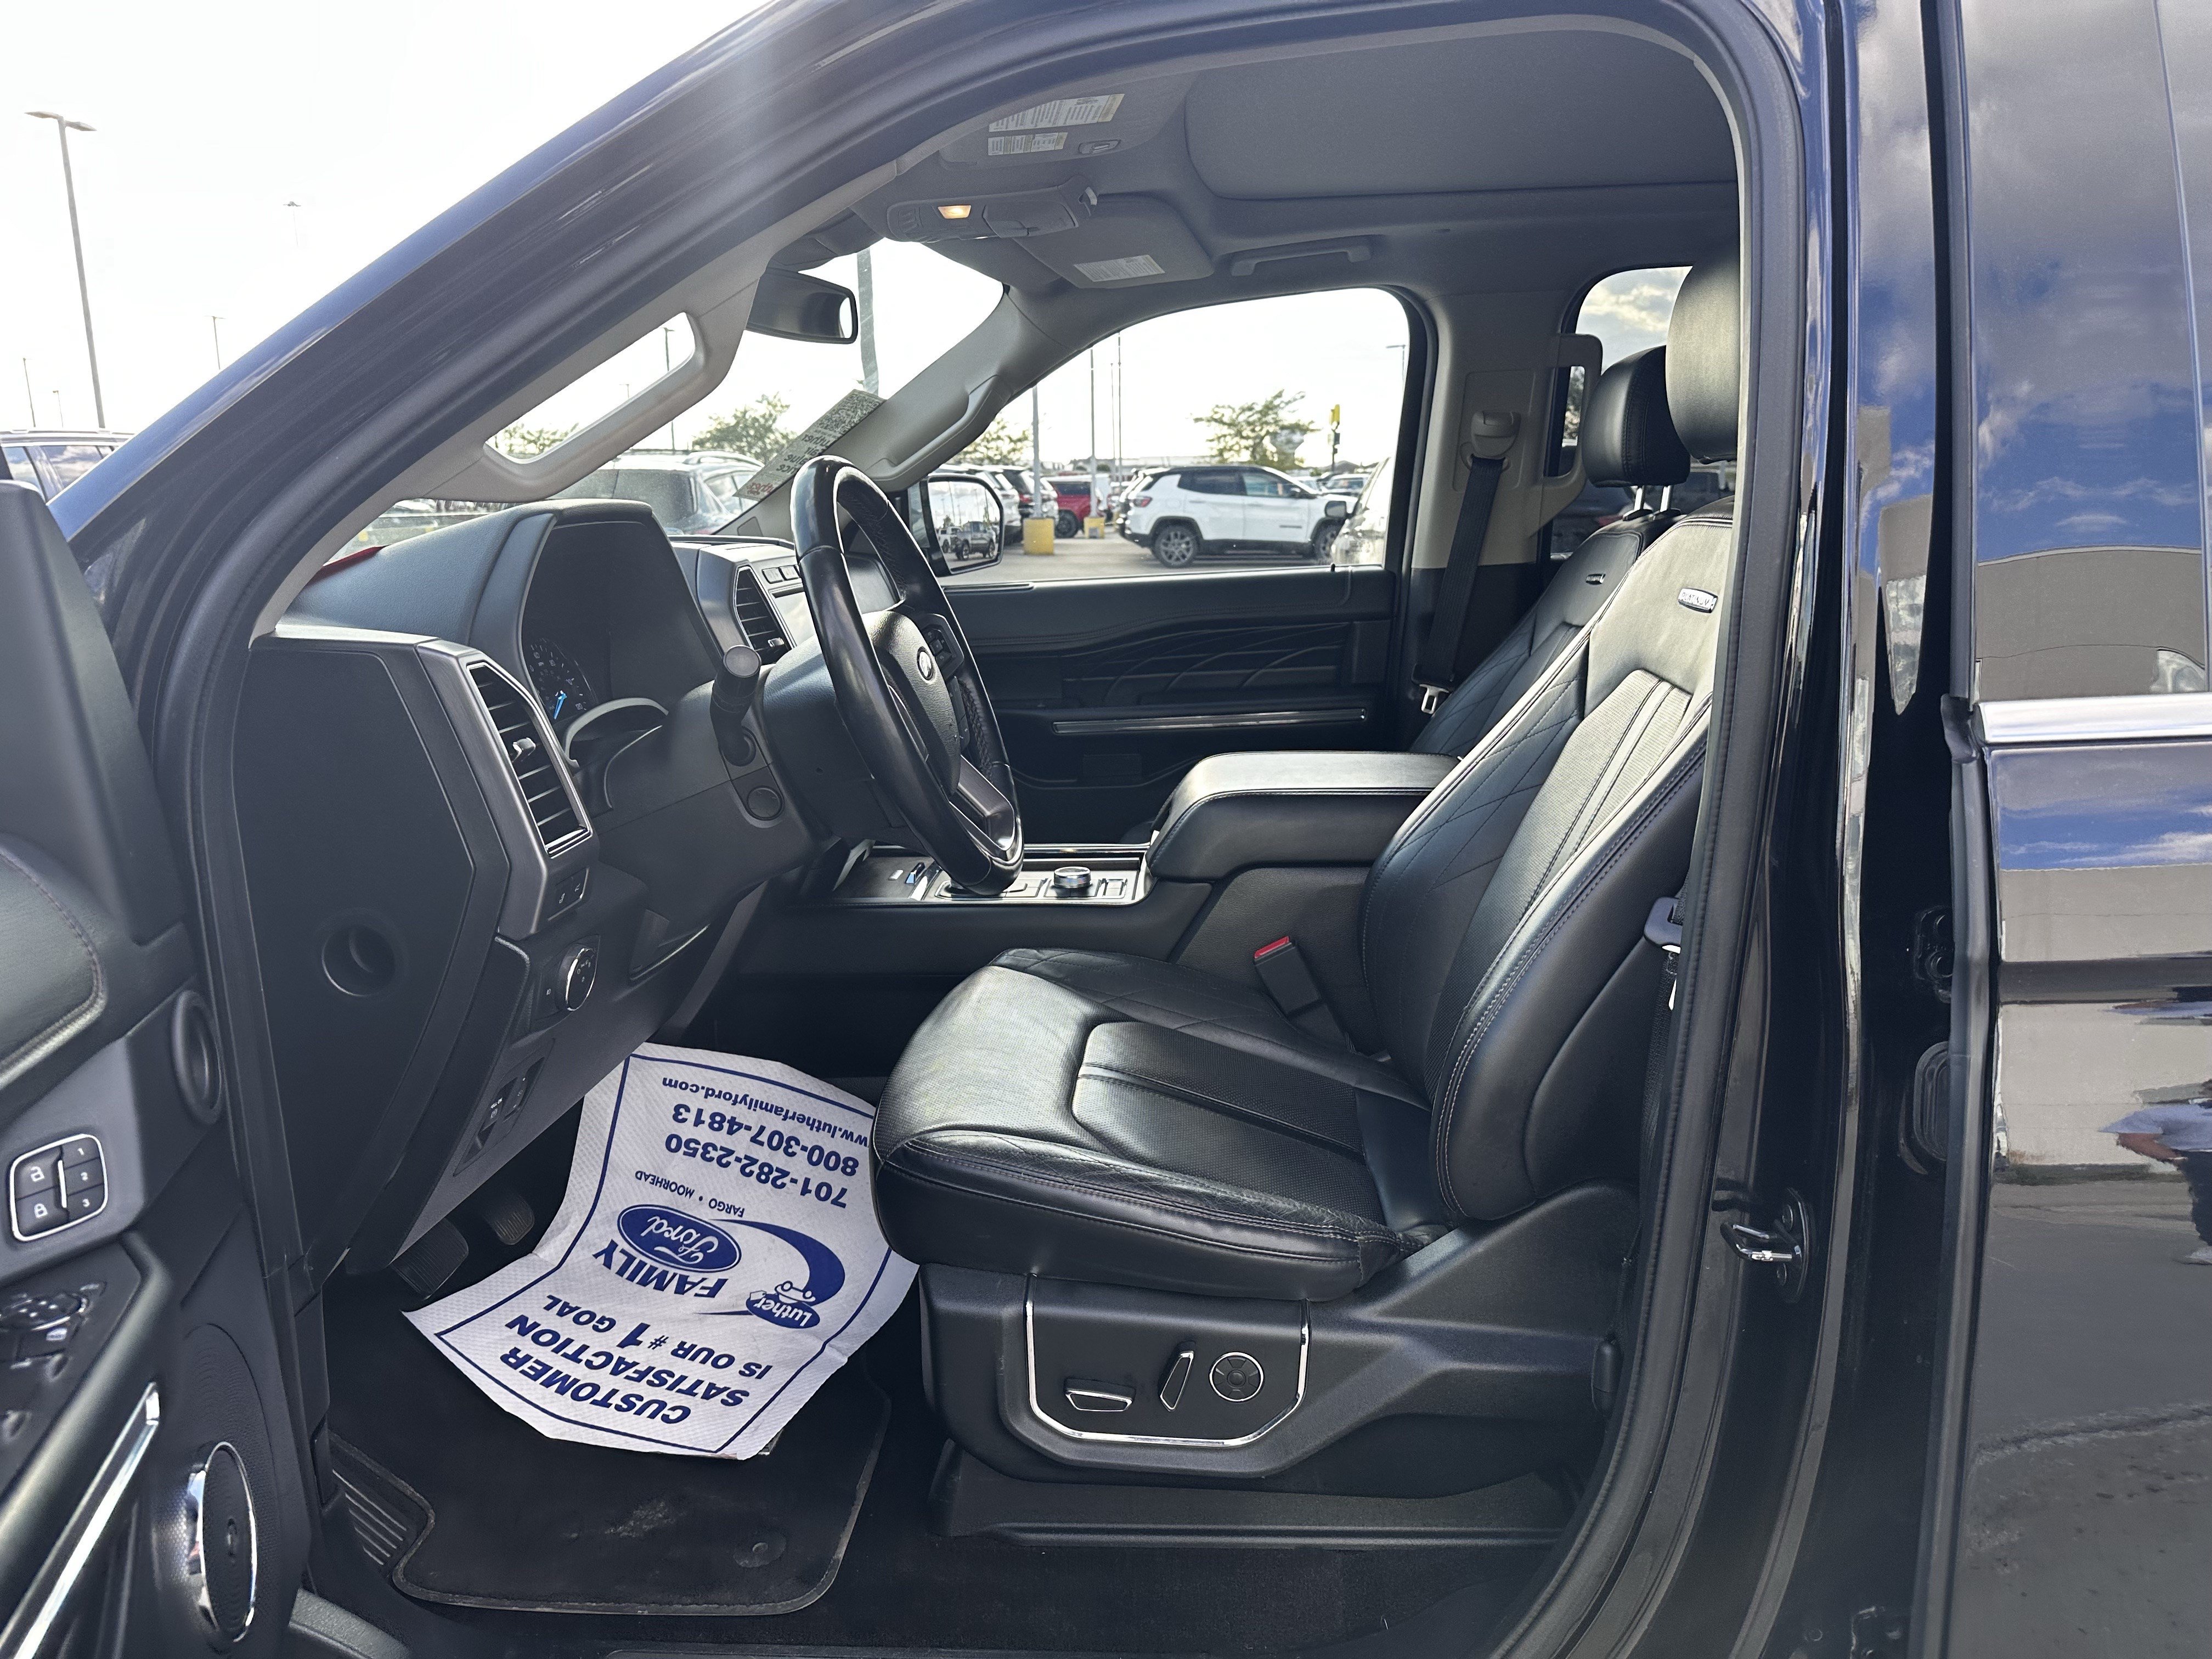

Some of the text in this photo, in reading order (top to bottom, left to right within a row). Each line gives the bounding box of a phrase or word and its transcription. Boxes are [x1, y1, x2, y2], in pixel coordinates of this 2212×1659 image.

[663, 1077, 869, 1149] ww.lutherfamilyford.com
[672, 1104, 859, 1176] 800-307-4813
[80, 1172, 88, 1181] 2
[635, 1170, 744, 1217] FARGO MOORHEAD
[665, 1134, 848, 1209] 701-282-2350
[82, 1199, 90, 1207] 3
[640, 1216, 719, 1264] Ford
[592, 1239, 729, 1298] FAMILY
[543, 1295, 616, 1333] GOAL
[753, 1297, 812, 1327] Luther
[505, 1314, 749, 1406] SATISFACTION
[670, 1340, 735, 1369] OUR
[738, 1362, 772, 1379] IS
[500, 1347, 691, 1424] CUSTOMER
